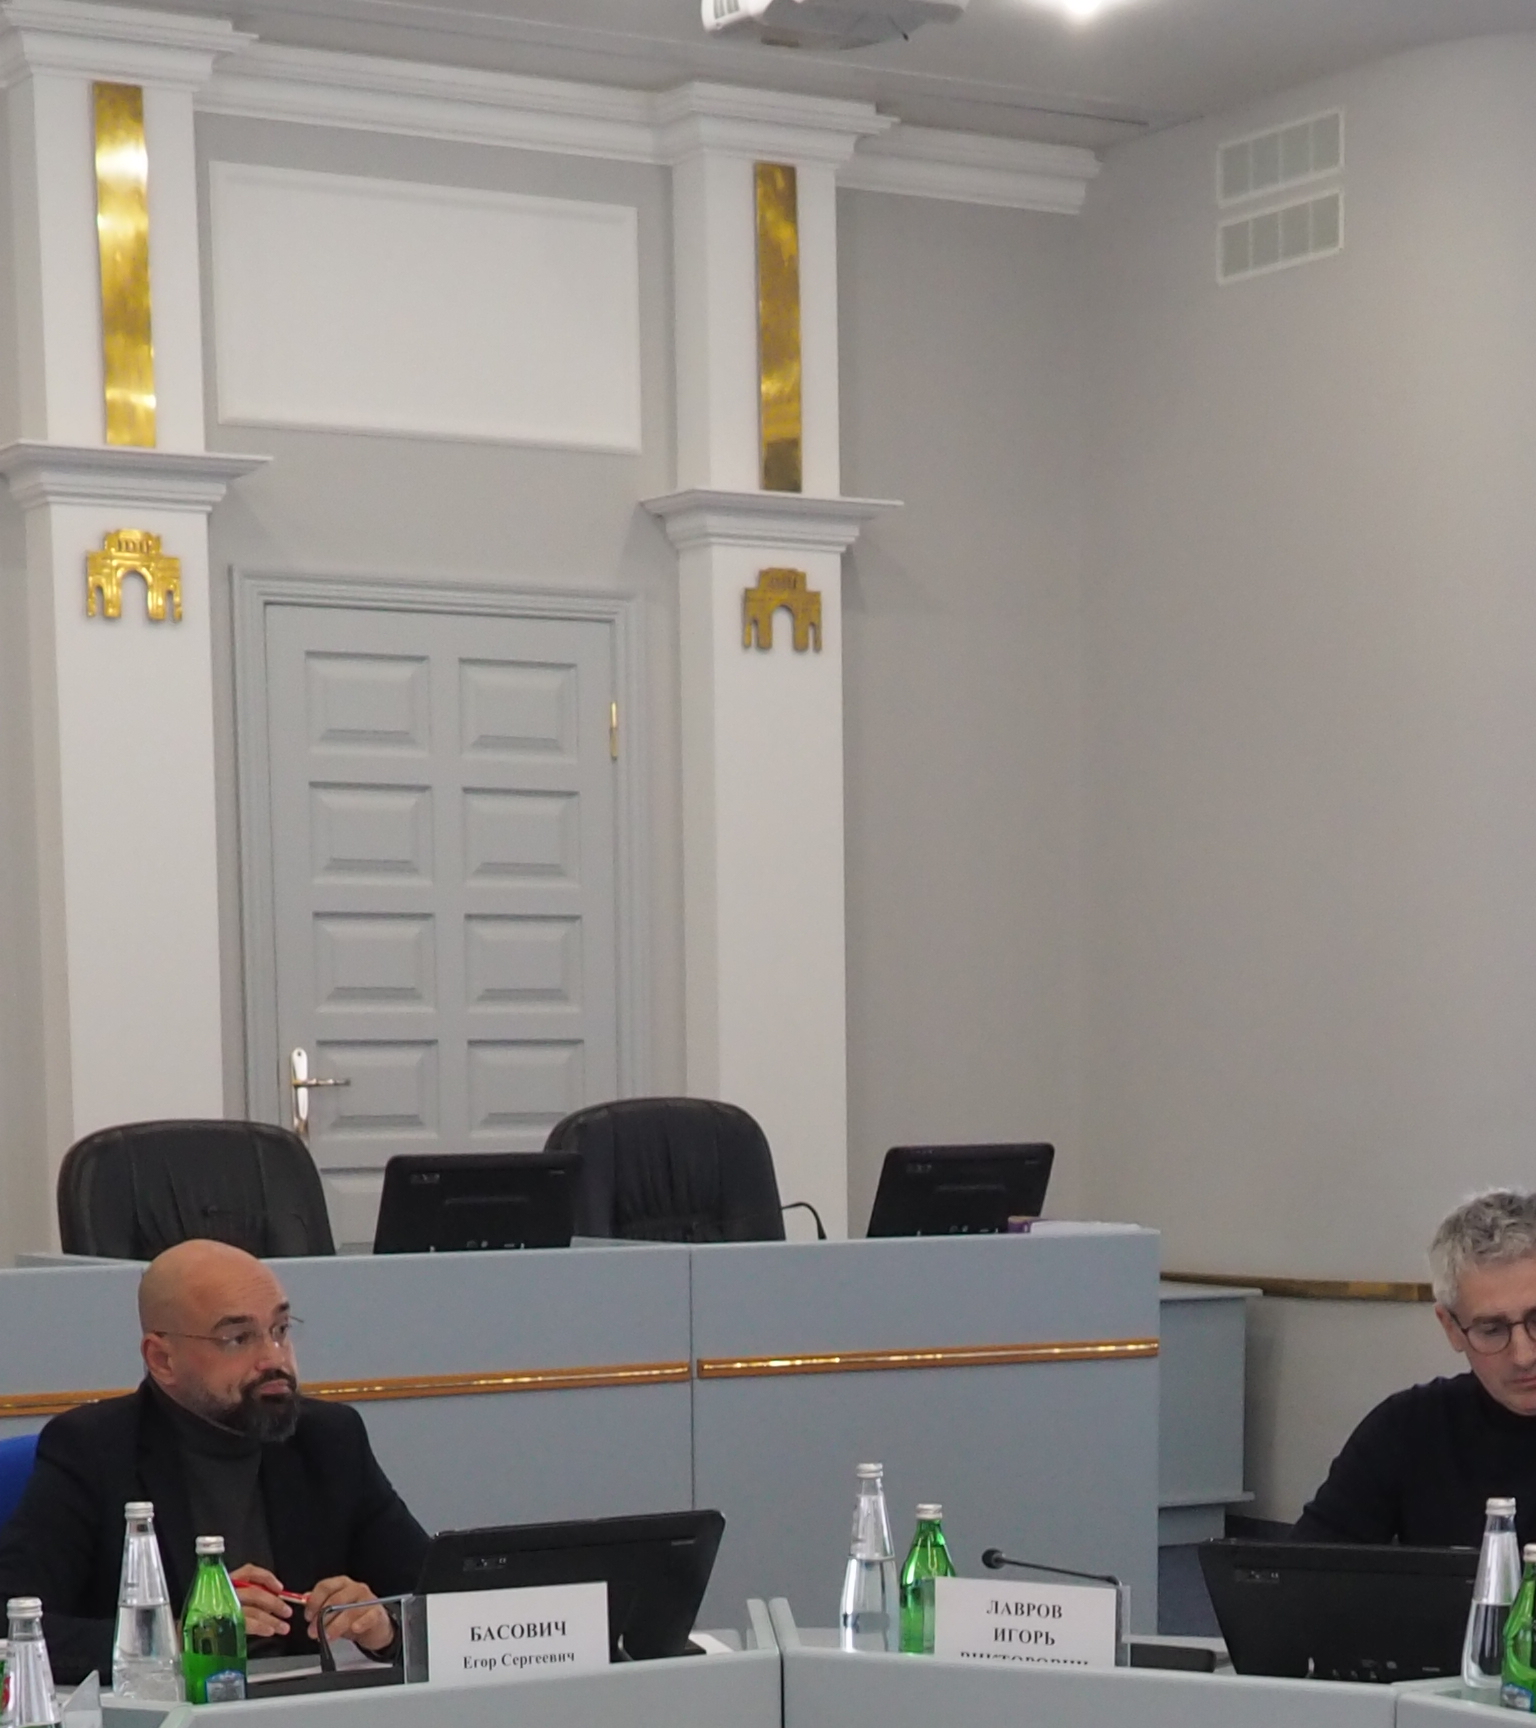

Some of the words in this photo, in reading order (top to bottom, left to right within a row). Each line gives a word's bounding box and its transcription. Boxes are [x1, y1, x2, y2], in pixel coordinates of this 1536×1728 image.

[986, 1600, 1062, 1619] ЛАВРОВ
[470, 1621, 566, 1642] БАСОВИЧ
[994, 1627, 1055, 1646] ИГОРЬ
[463, 1656, 497, 1671] Егор
[501, 1652, 575, 1669] Сергеевич
